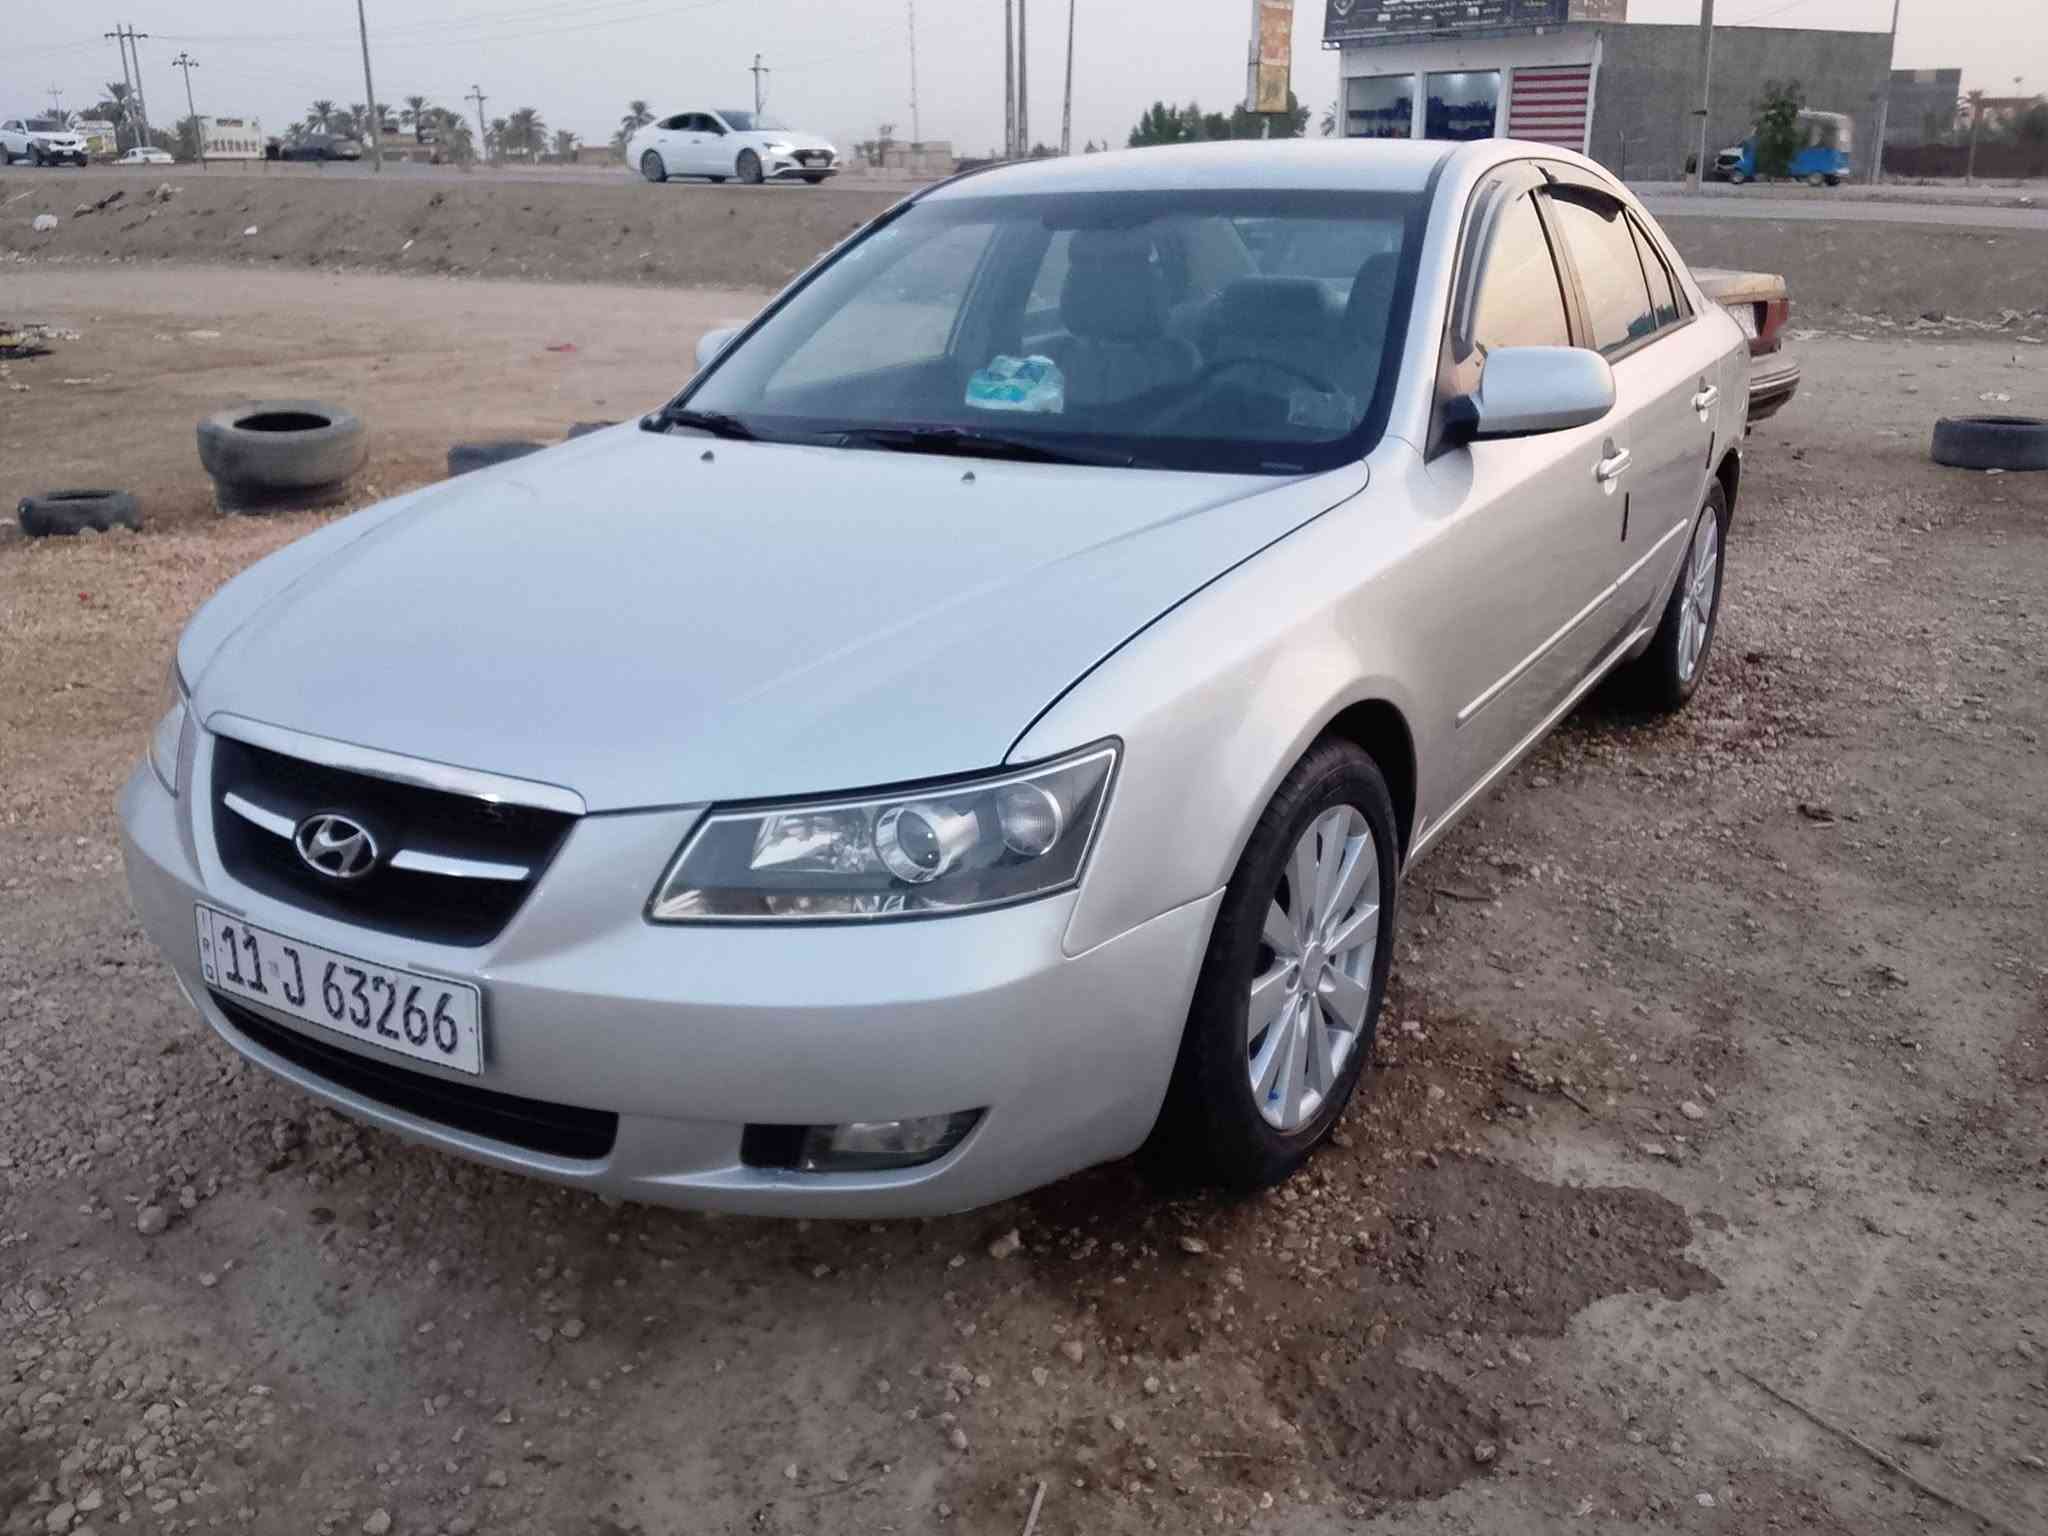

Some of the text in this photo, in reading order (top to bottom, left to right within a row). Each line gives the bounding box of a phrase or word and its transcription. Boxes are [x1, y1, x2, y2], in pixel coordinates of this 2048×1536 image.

[221, 925, 459, 1055] 11 J 63266
